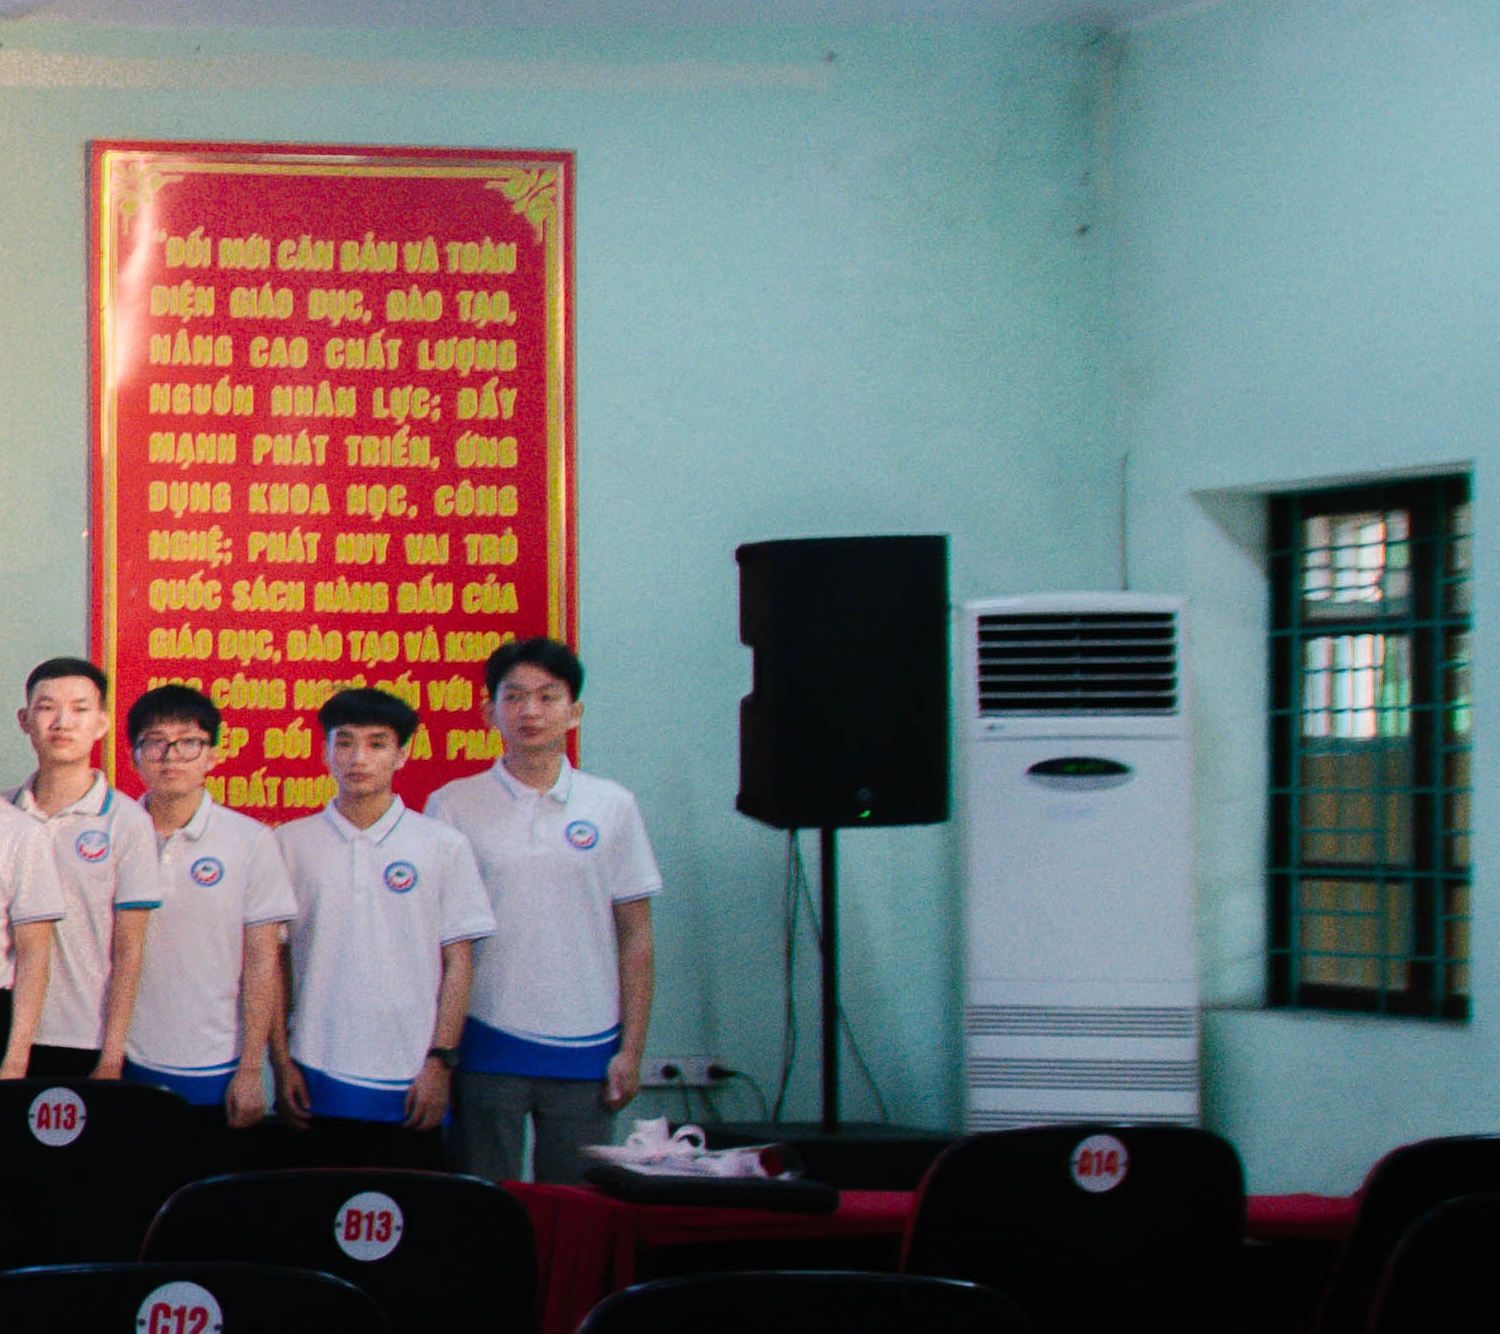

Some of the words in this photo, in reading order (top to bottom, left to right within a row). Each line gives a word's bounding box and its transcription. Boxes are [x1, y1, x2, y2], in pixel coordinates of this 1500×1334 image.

[219, 233, 270, 269] MỚI
[278, 235, 333, 271] CĂN
[341, 232, 397, 272] BẢN
[404, 237, 438, 273] VÀ
[447, 237, 516, 273] TOÀN
[150, 281, 214, 323] DIỆN
[230, 283, 293, 319] GIÁO
[308, 290, 371, 325] DỤC,
[387, 285, 442, 321] ĐÀO
[458, 291, 517, 329] TẠO,
[150, 329, 232, 365] NÂNG
[250, 337, 308, 367] CAO
[325, 330, 401, 367] CHẤT
[418, 337, 517, 376] LƯỢNG
[272, 381, 356, 416] NHÂN
[374, 384, 440, 423] LỰC;
[149, 434, 236, 470] MẠNH
[252, 430, 329, 466] PHÁT
[455, 431, 518, 467] ỨNG
[149, 482, 230, 518] DỤNG
[249, 482, 329, 514] KHOA
[347, 485, 416, 521] HỌC,
[434, 480, 518, 515] CÔNG
[248, 527, 320, 562] PHÁT
[335, 534, 389, 564] HUY
[405, 535, 449, 564] VAI
[465, 530, 518, 565] TRÒ
[149, 571, 222, 611] QUỐC
[232, 575, 305, 611] SÁCH
[315, 577, 388, 613] HÀNG
[462, 573, 518, 613] CỦA
[149, 622, 212, 660] GIÁO
[218, 629, 282, 667] DỤC,
[286, 625, 343, 662] ĐÀO
[347, 632, 399, 668] TẠO
[404, 630, 440, 662] VÀ
[211, 672, 286, 710] CÔNG
[427, 675, 472, 712] VỚI
[229, 768, 281, 807] ĐẤT
[343, 1209, 392, 1242] B13
